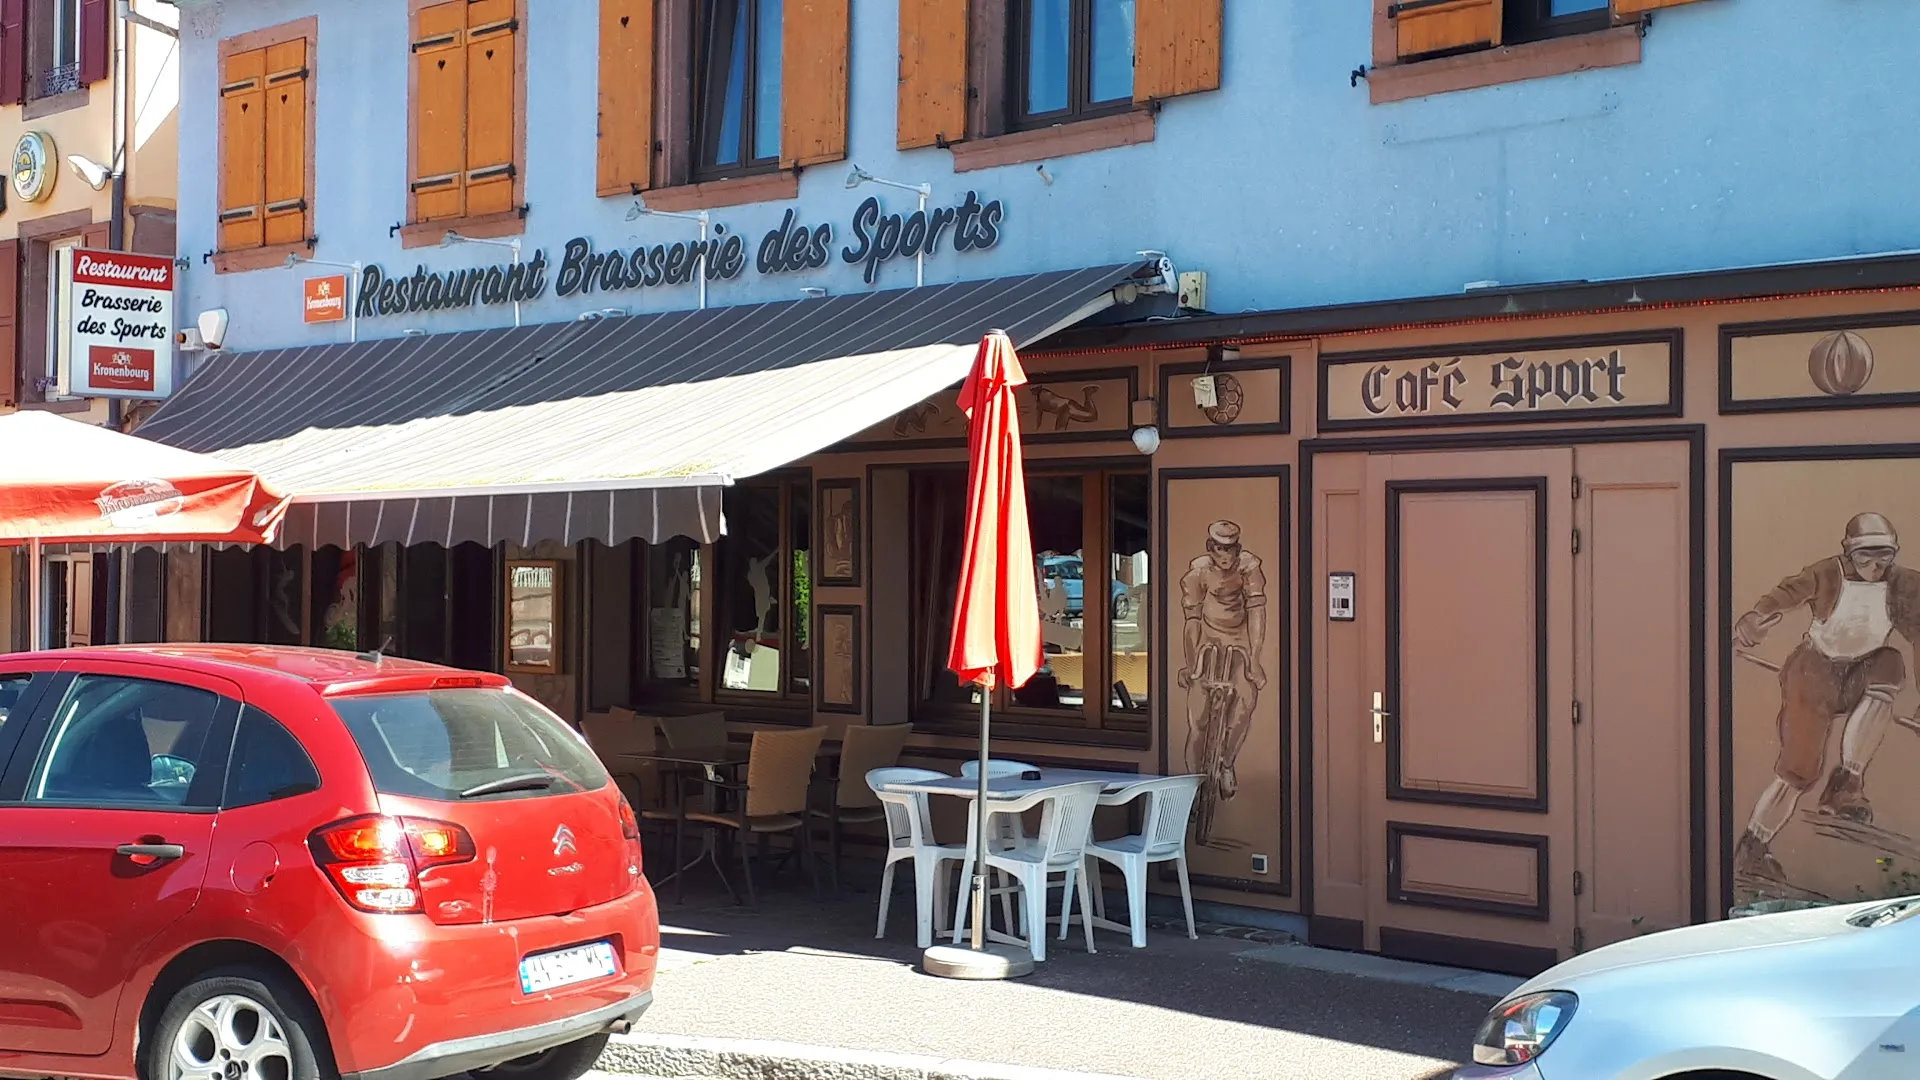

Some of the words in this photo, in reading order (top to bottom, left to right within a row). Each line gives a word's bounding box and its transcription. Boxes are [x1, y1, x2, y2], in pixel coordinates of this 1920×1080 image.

[355, 249, 549, 318] Restaurant
[556, 223, 745, 297] Brasserie
[756, 208, 834, 275] des
[841, 190, 1005, 284] Sports
[77, 256, 168, 283] Restaurant
[81, 289, 163, 313] Brasserie
[77, 315, 106, 335] des
[110, 317, 167, 343] Sports
[93, 362, 150, 382] Kronenbourg
[1361, 357, 1468, 416] Café
[1489, 349, 1627, 410] Sport
